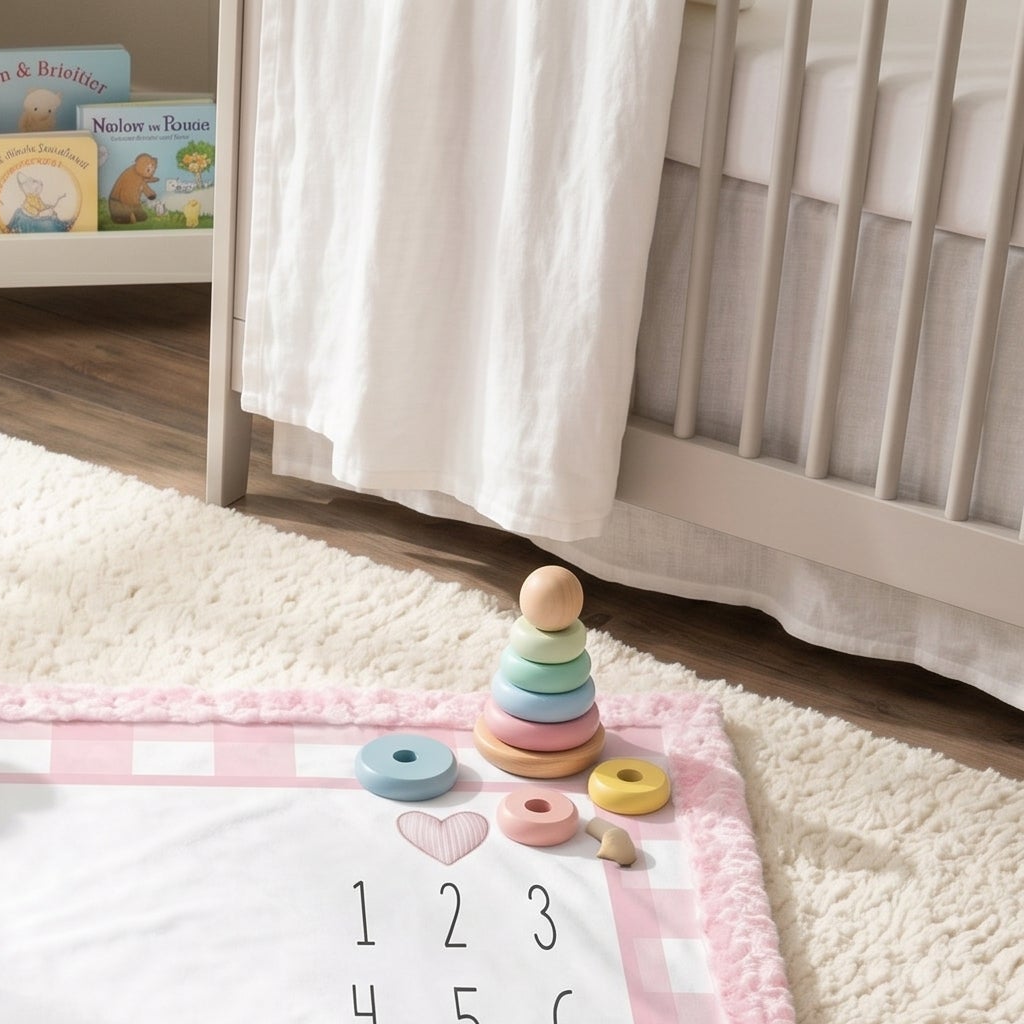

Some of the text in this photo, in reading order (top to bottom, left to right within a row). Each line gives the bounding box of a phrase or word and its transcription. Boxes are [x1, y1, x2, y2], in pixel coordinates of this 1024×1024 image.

[16, 61, 31, 78] &
[353, 881, 556, 950] 1 2 3
